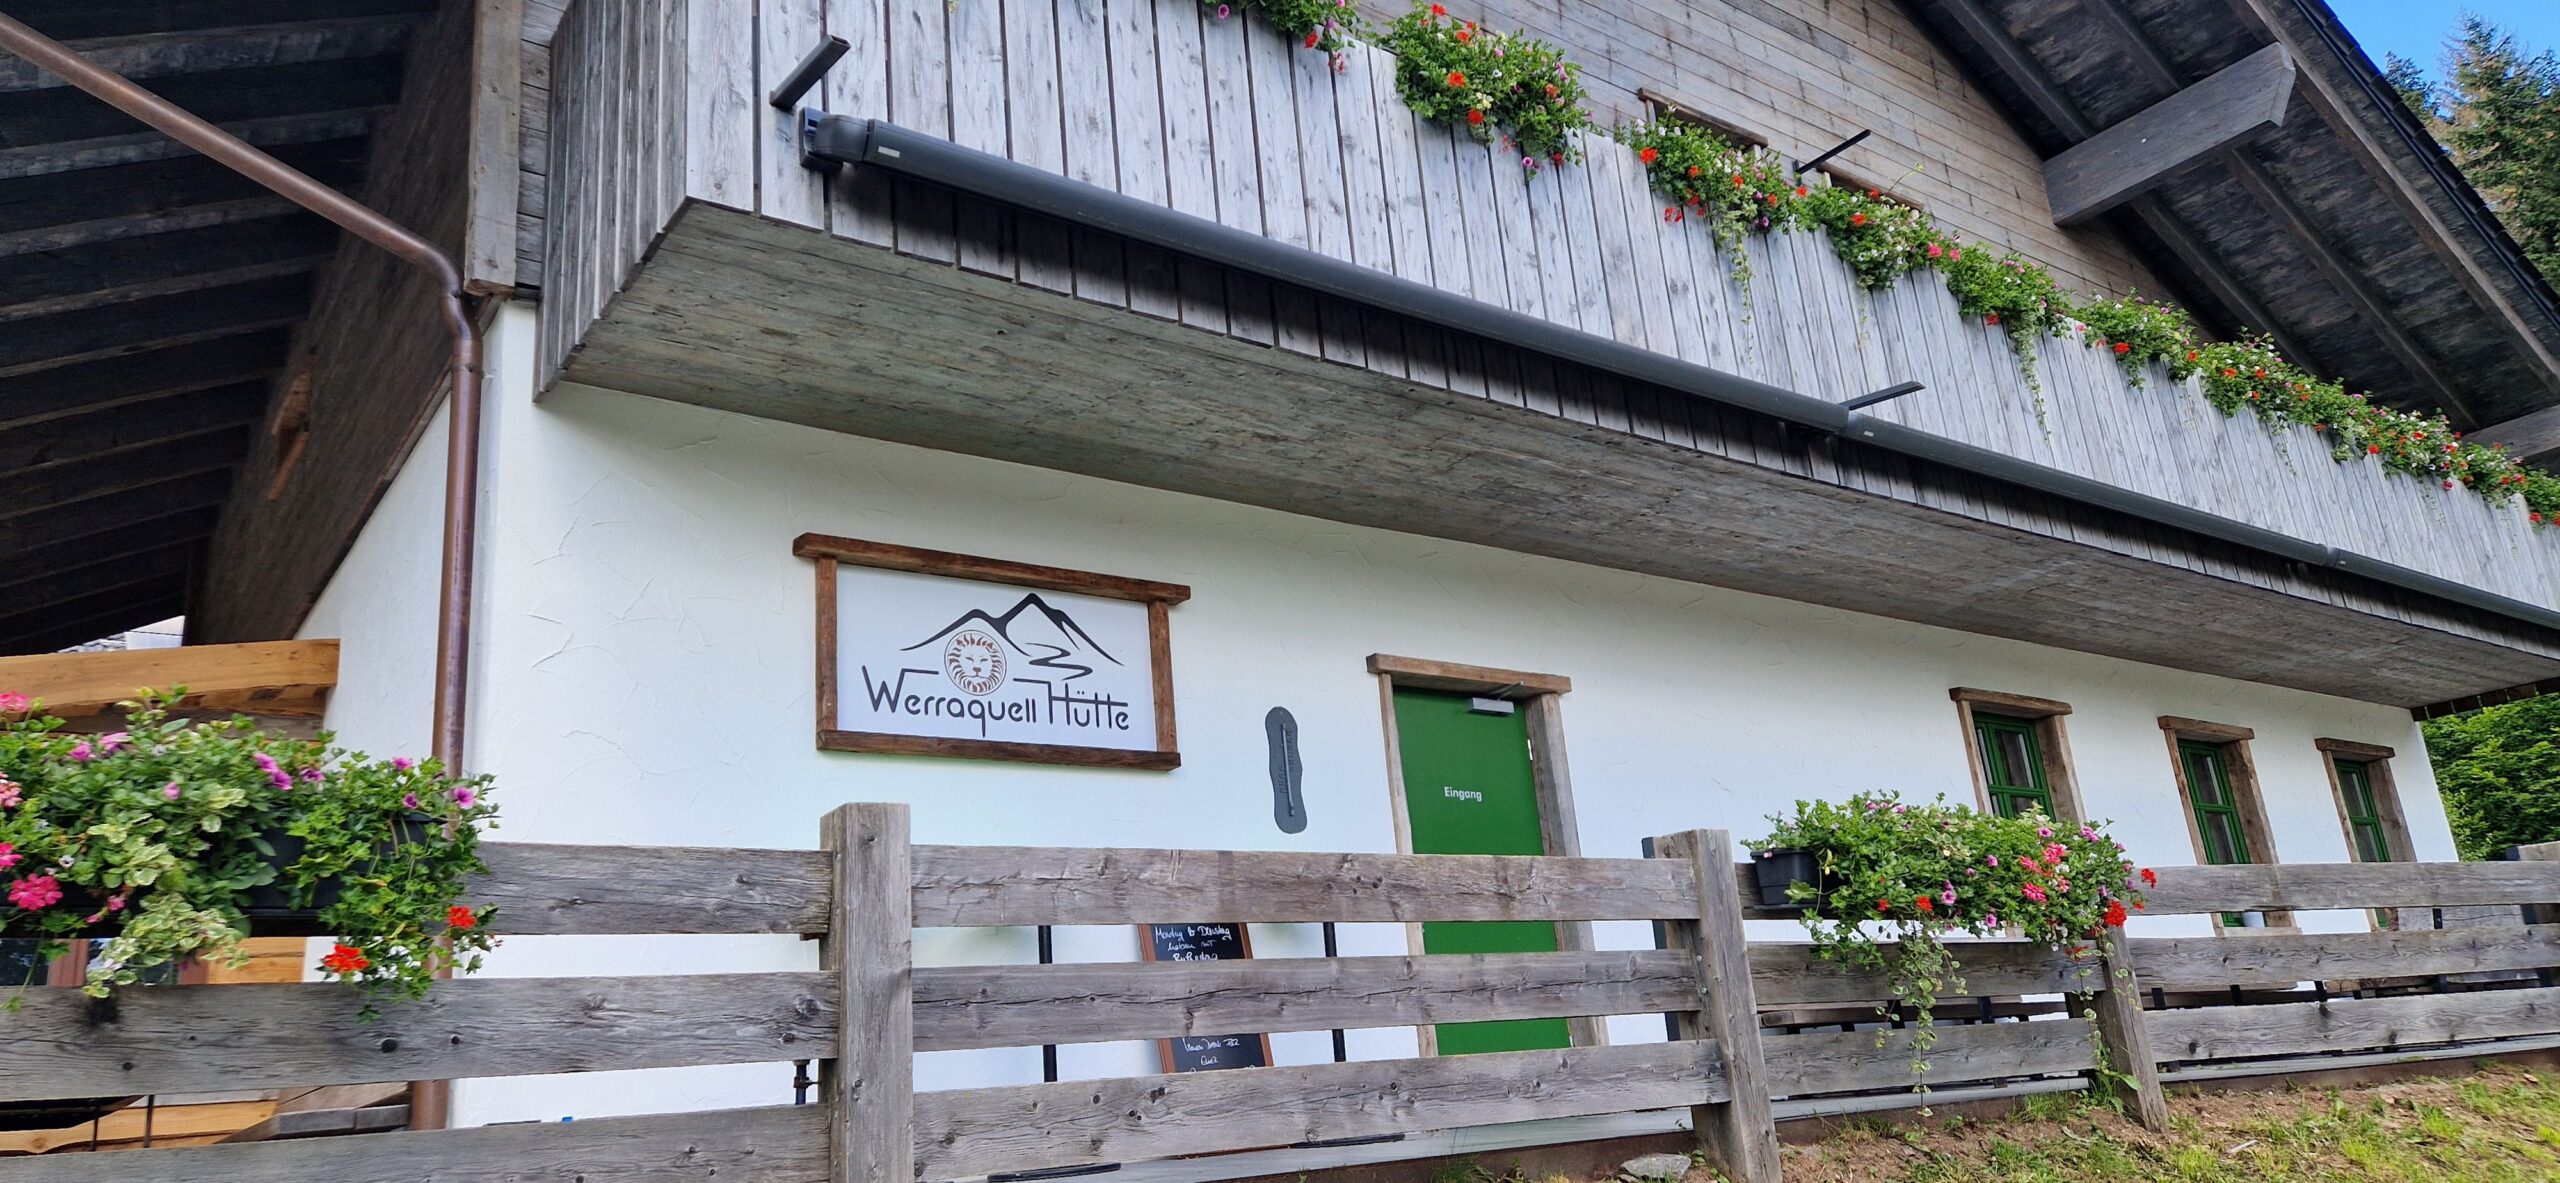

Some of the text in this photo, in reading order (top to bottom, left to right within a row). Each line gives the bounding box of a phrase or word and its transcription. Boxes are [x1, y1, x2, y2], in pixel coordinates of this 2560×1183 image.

[861, 664, 1129, 738] Werraquell Hütte
[1444, 786, 1483, 802] Eingang
